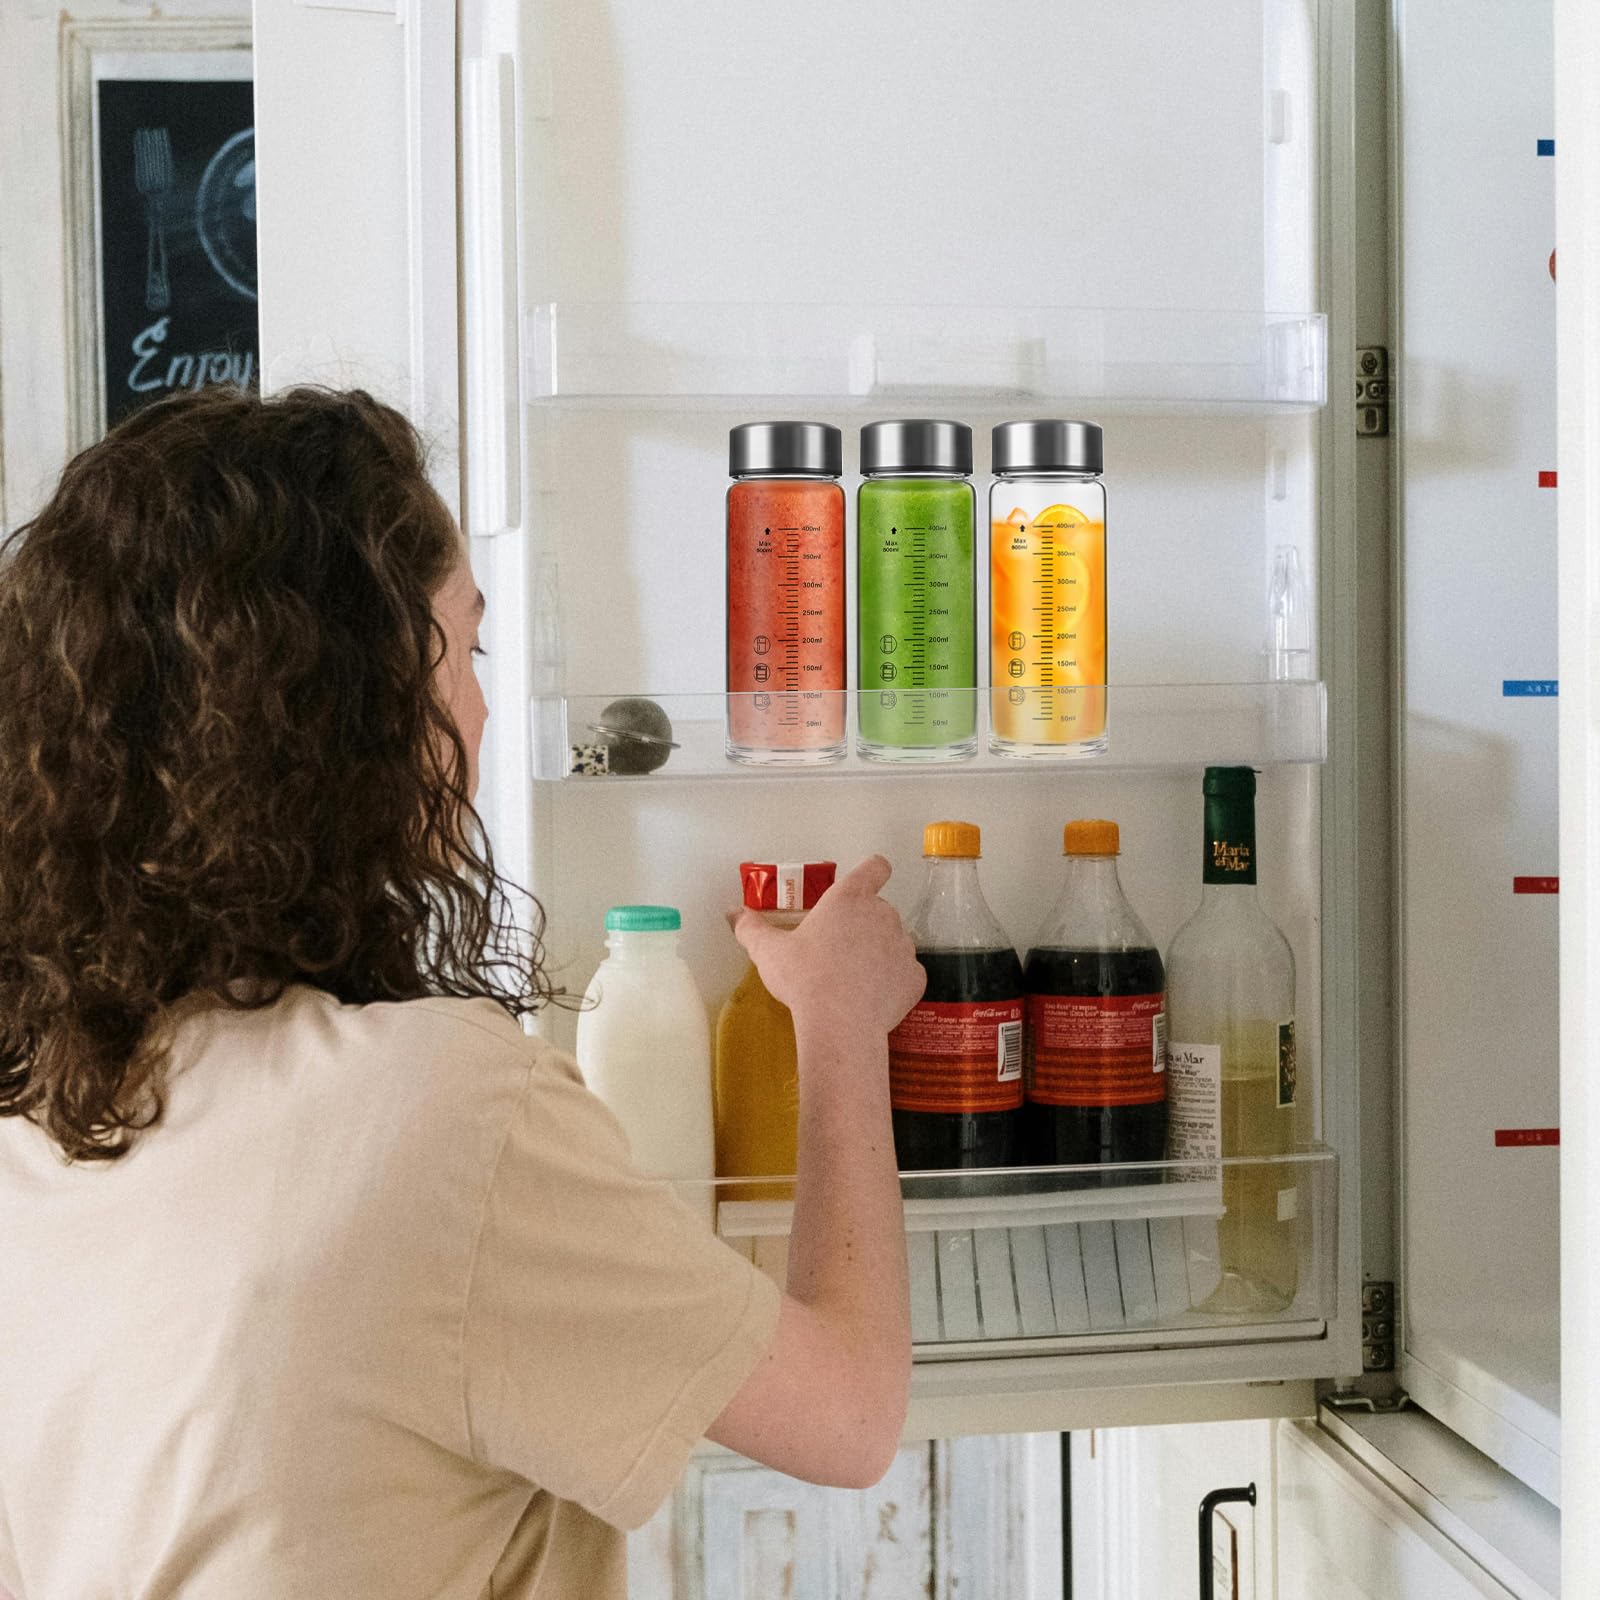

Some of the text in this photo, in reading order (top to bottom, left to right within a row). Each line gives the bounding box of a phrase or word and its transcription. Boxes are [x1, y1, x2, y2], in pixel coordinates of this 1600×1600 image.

[127, 315, 253, 393] Enjoy
[1213, 841, 1250, 857] Maria
[1226, 857, 1250, 871] Mar
[1183, 1052, 1205, 1064] Mar
